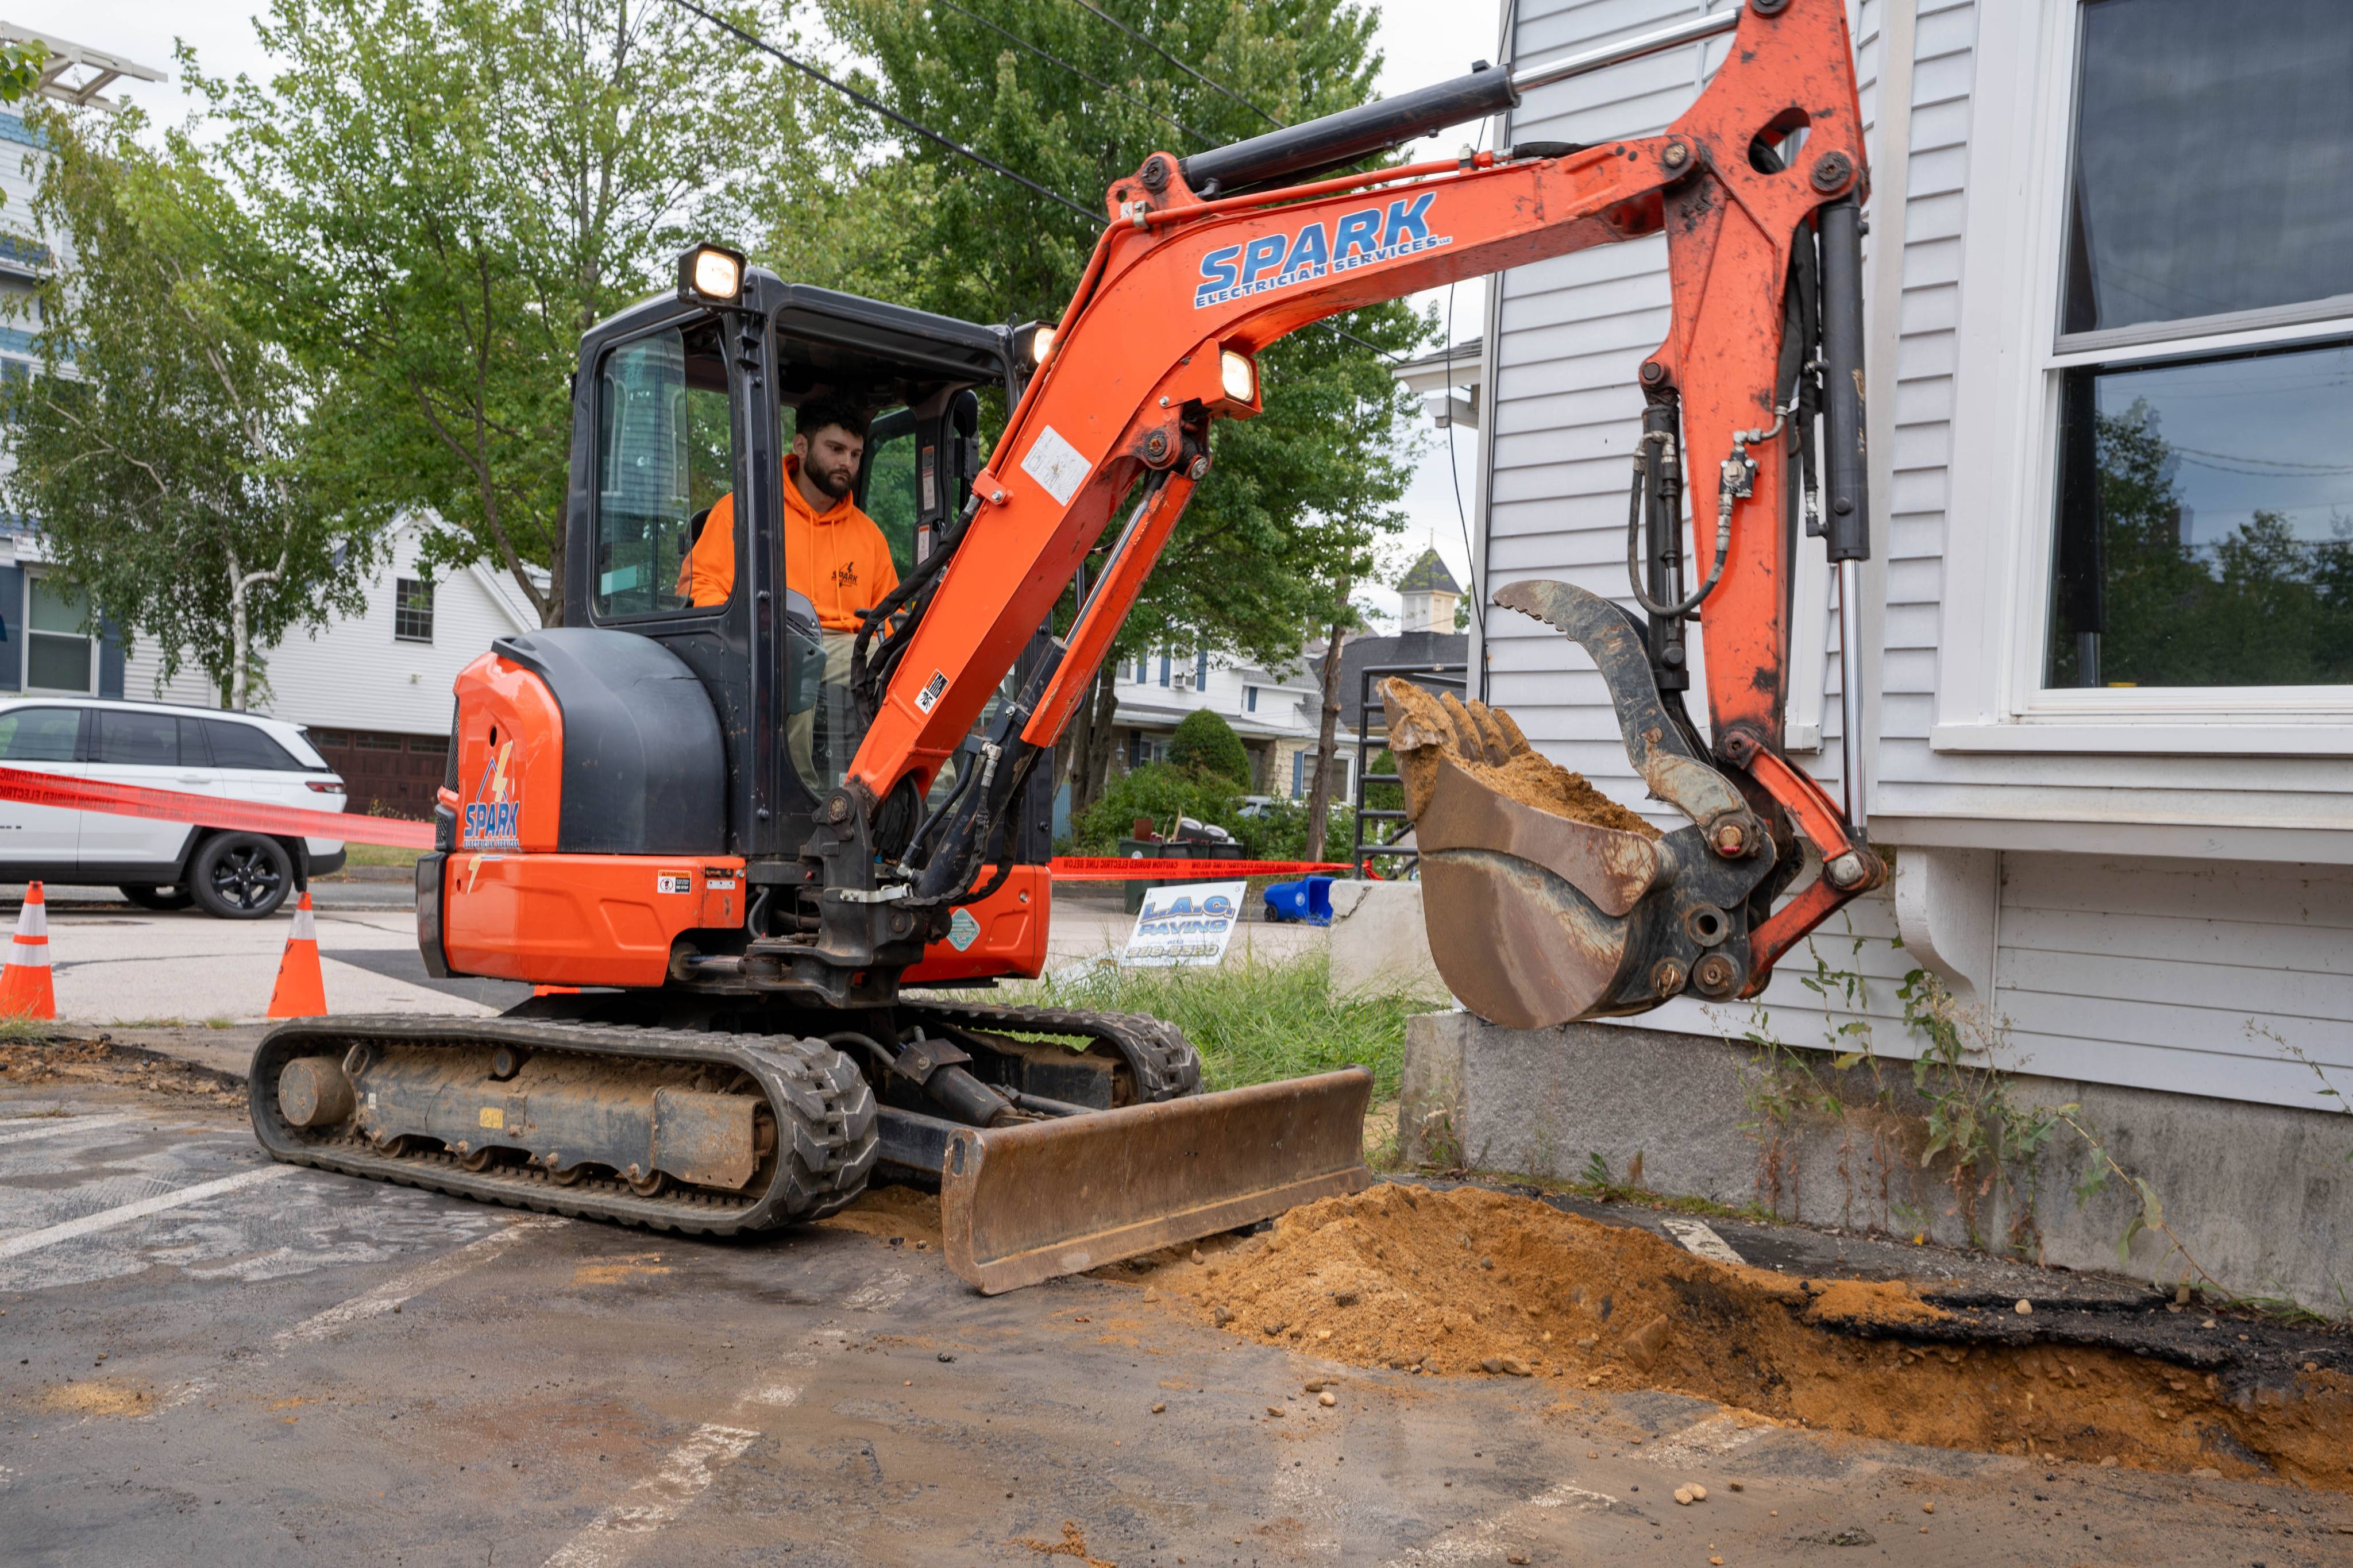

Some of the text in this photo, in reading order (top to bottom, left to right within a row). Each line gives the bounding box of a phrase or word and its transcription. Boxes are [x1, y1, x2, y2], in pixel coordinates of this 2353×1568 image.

[1197, 192, 1437, 296] SPARK
[1195, 265, 1326, 308] ELECTRICIAN
[1334, 236, 1437, 272] SERVICES
[832, 570, 858, 584] SPARK
[464, 801, 519, 839] SPARK
[464, 839, 519, 849] ELECTRICIAN SERVICES
[1140, 896, 1236, 924] L.A.C.
[1138, 920, 1228, 936] PAVING
